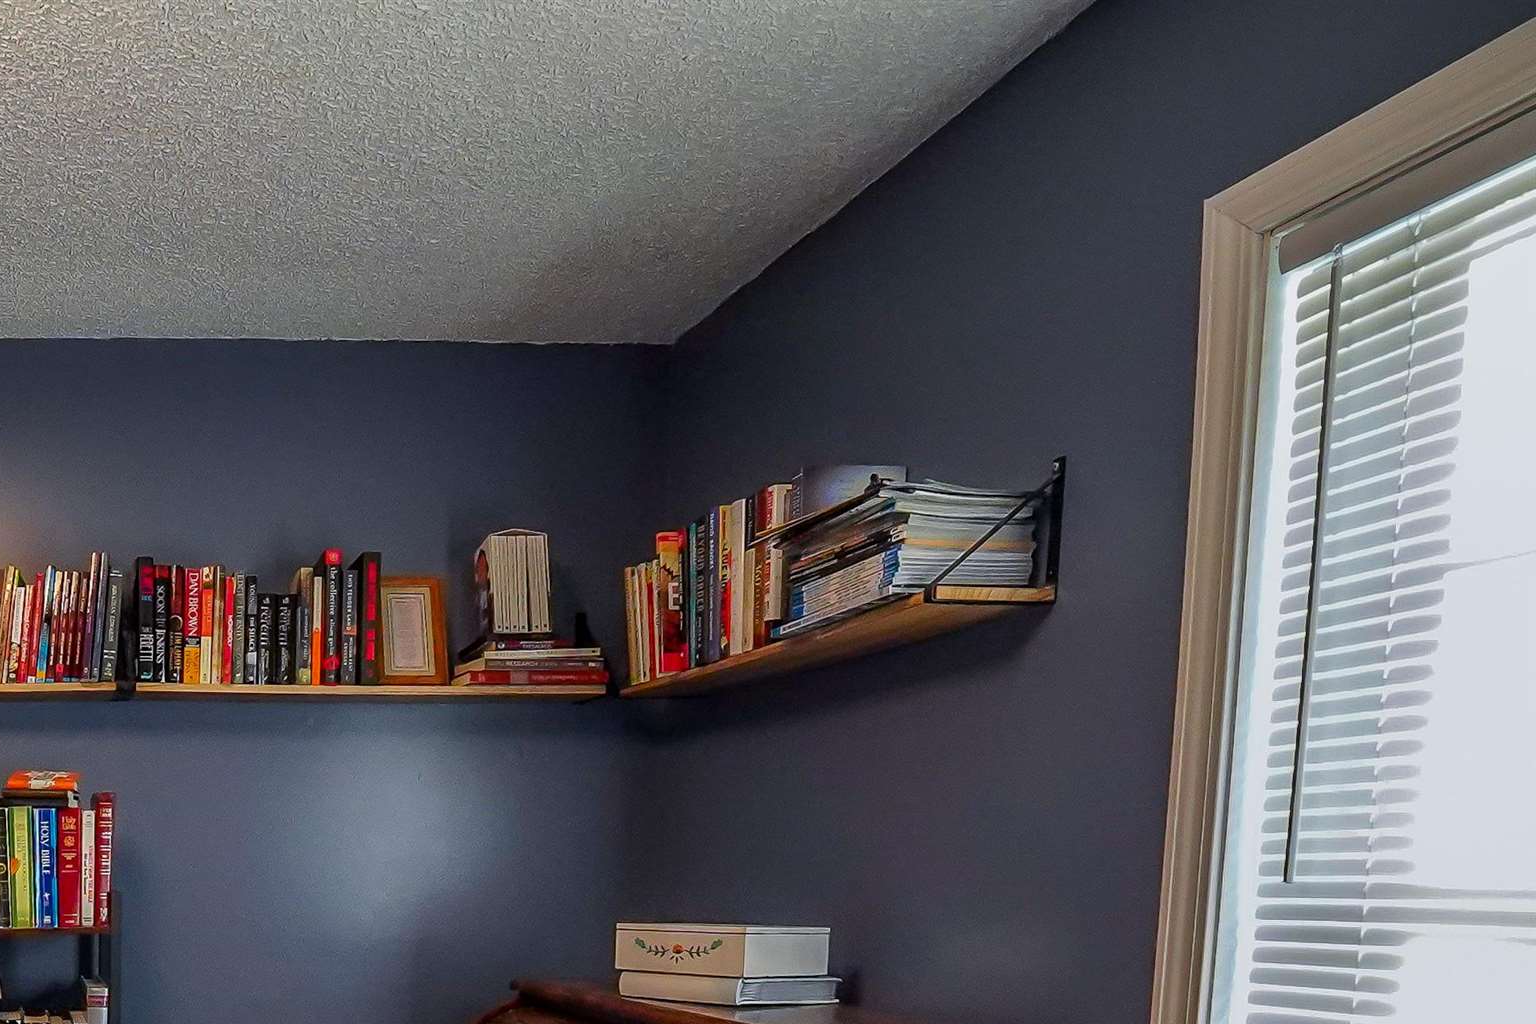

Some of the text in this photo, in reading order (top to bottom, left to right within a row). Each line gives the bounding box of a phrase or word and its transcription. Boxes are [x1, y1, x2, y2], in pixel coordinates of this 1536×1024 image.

[696, 526, 705, 571] BEYOND
[156, 585, 166, 613] SOON
[188, 572, 199, 636] DAN BROWN
[328, 580, 337, 616] collective
[696, 576, 705, 612] ORDER
[155, 628, 165, 664] JENKINS
[40, 821, 50, 877] HOLY BIBLE
